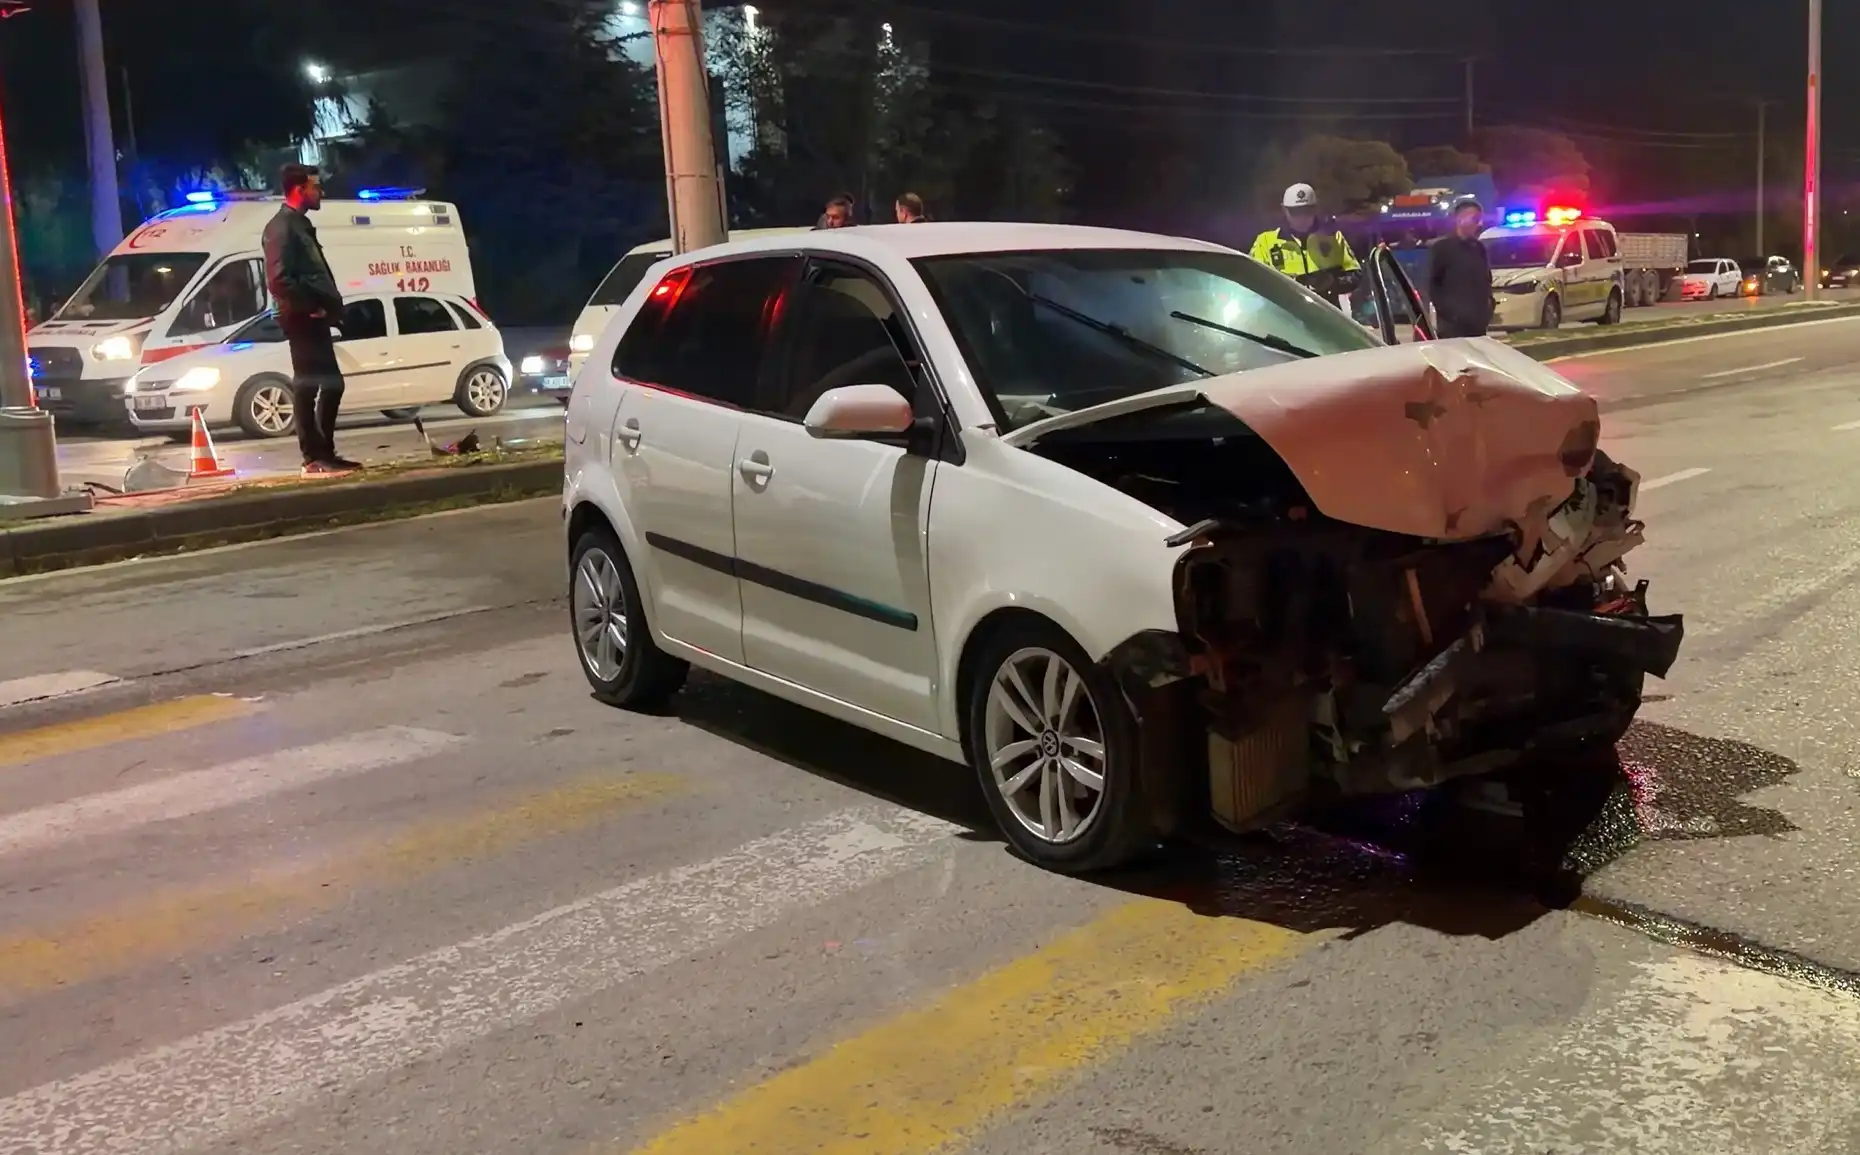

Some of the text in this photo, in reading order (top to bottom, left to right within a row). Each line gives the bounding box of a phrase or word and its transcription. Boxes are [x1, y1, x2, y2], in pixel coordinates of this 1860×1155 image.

[400, 246, 416, 258] T.C.
[368, 258, 451, 275] SAĞLIK BAKANLIĞI
[397, 277, 429, 292] 112
